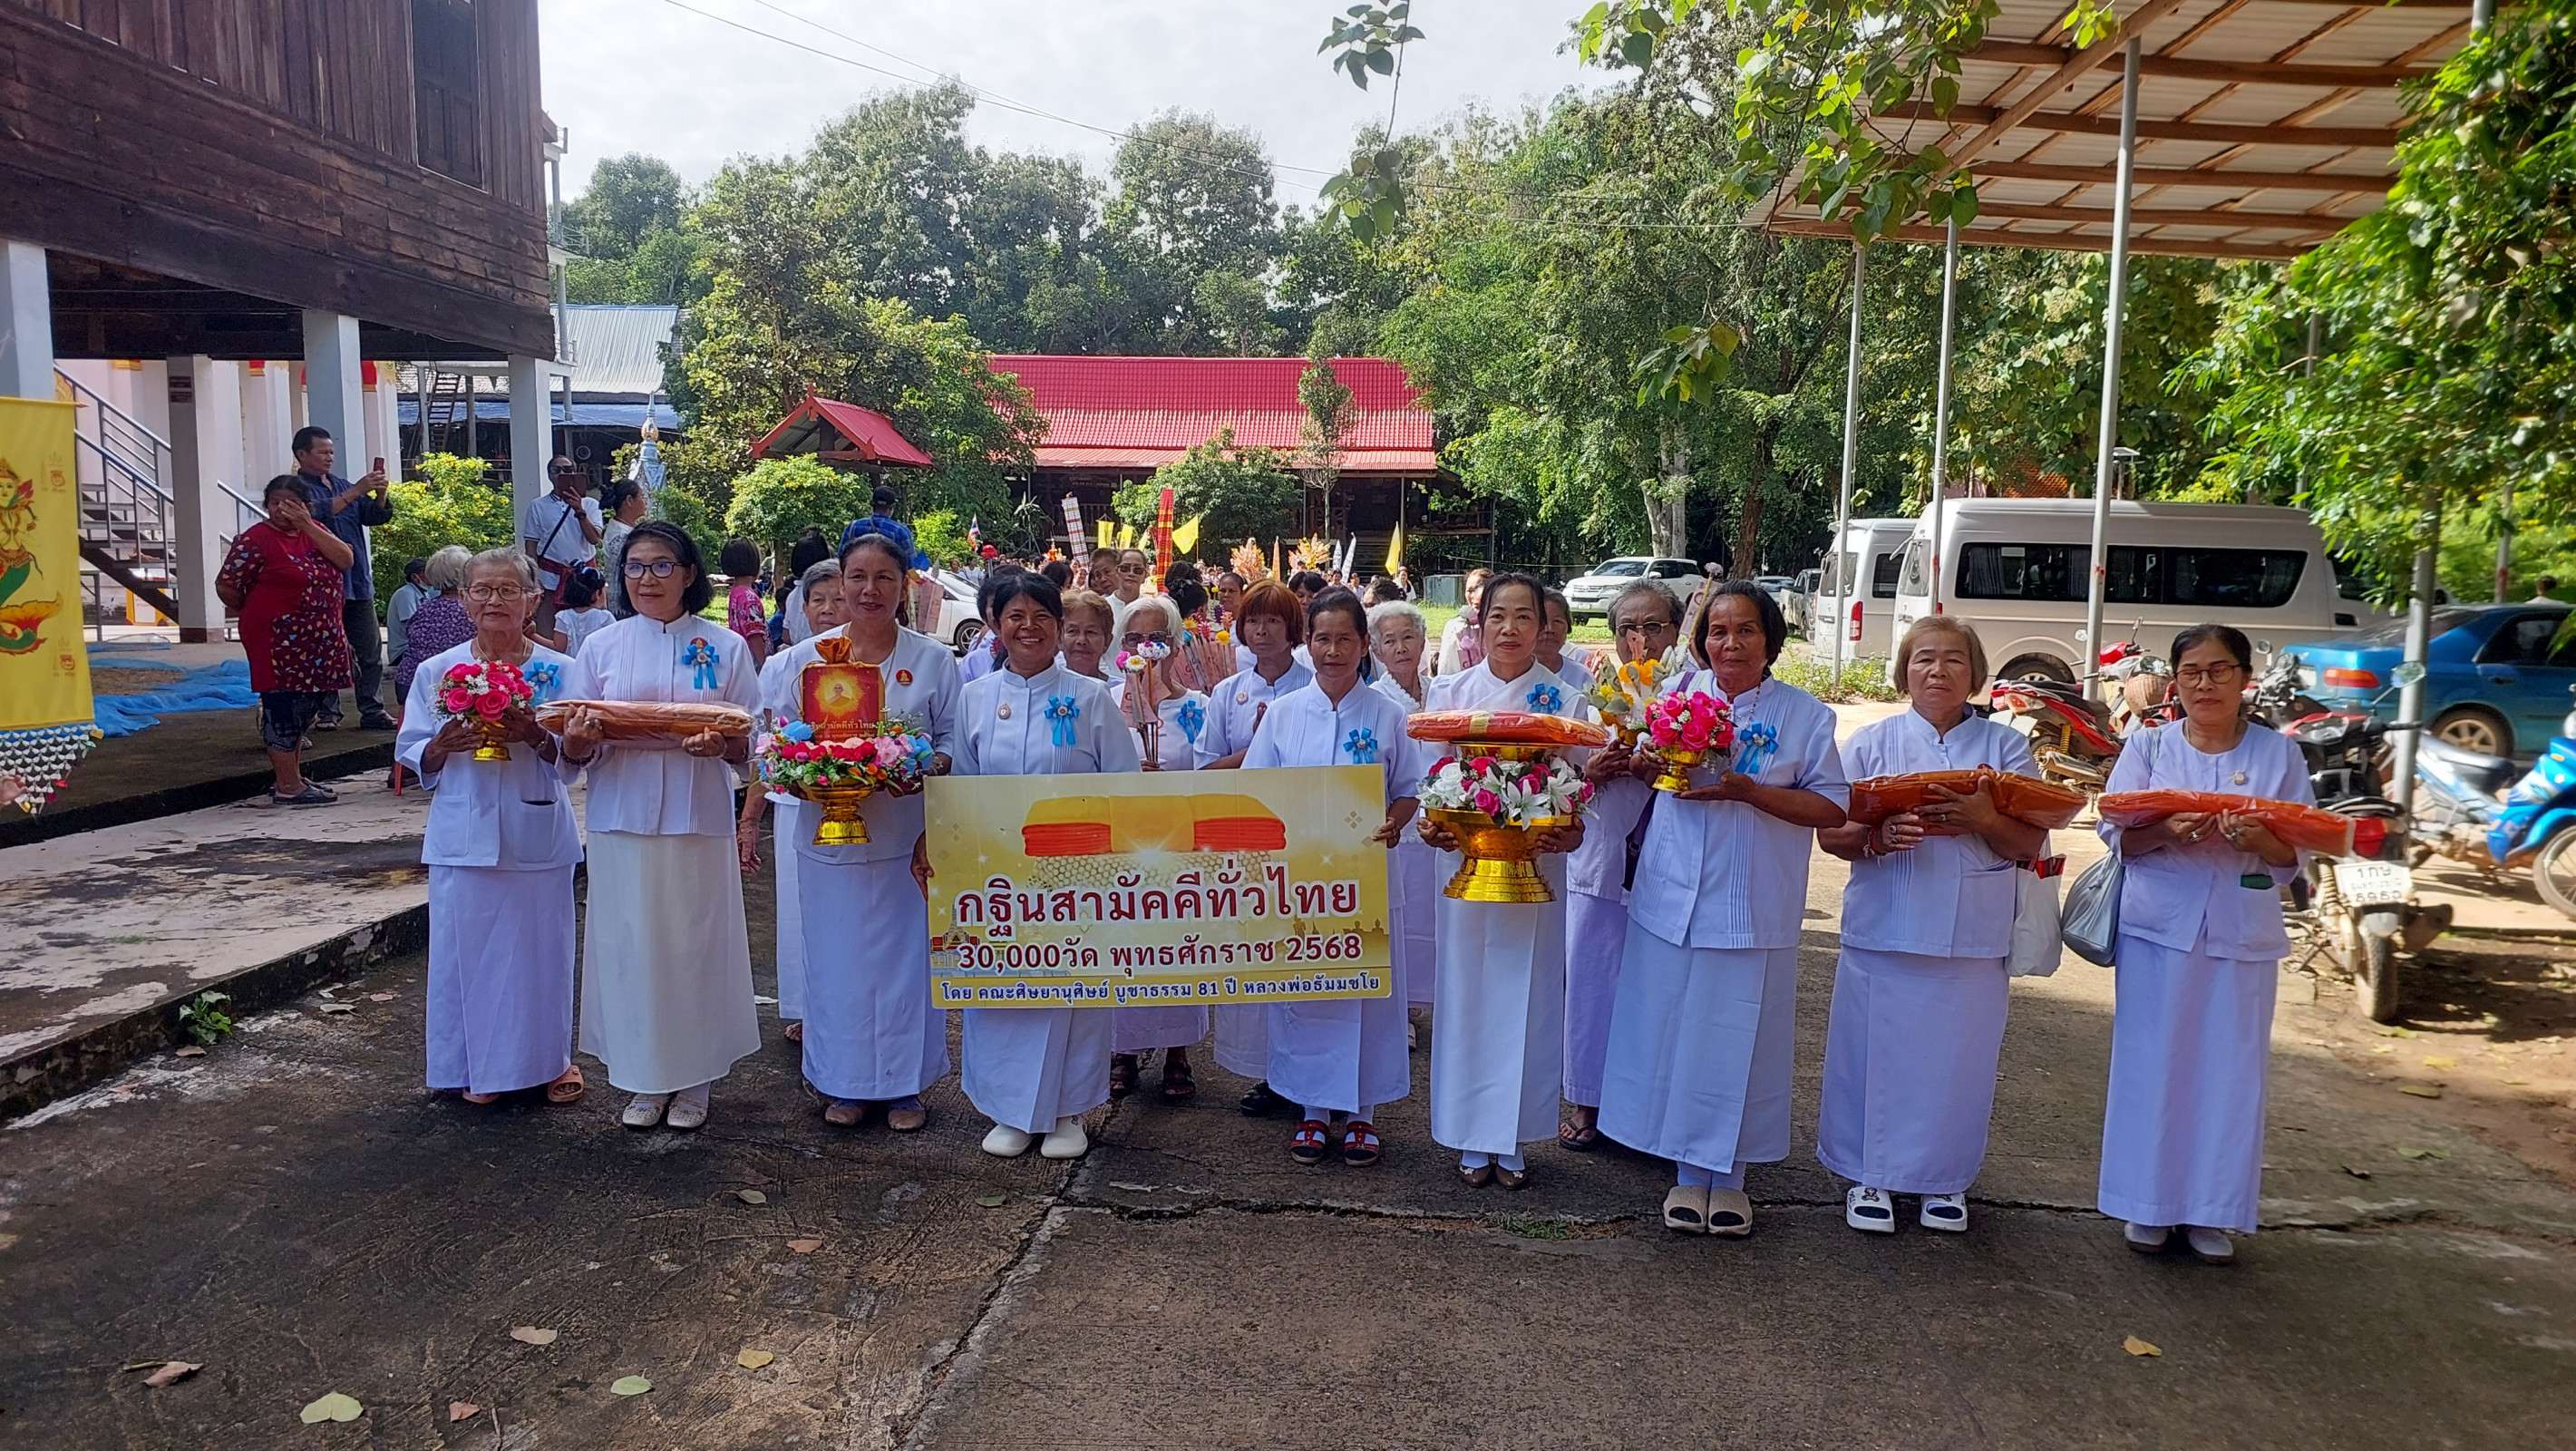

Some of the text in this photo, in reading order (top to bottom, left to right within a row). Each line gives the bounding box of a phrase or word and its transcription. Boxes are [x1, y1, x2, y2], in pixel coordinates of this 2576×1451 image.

[957, 859, 1356, 937] กฐินสามัคคีทั่วไทย
[958, 934, 1362, 978] 30,000วัด พุทธศักราช 2568
[941, 972, 1380, 1004] โดย คณะศิษยานุศิษย์ บูชาธรรม 81 ปี หลวงพ่อธัมมชโย
